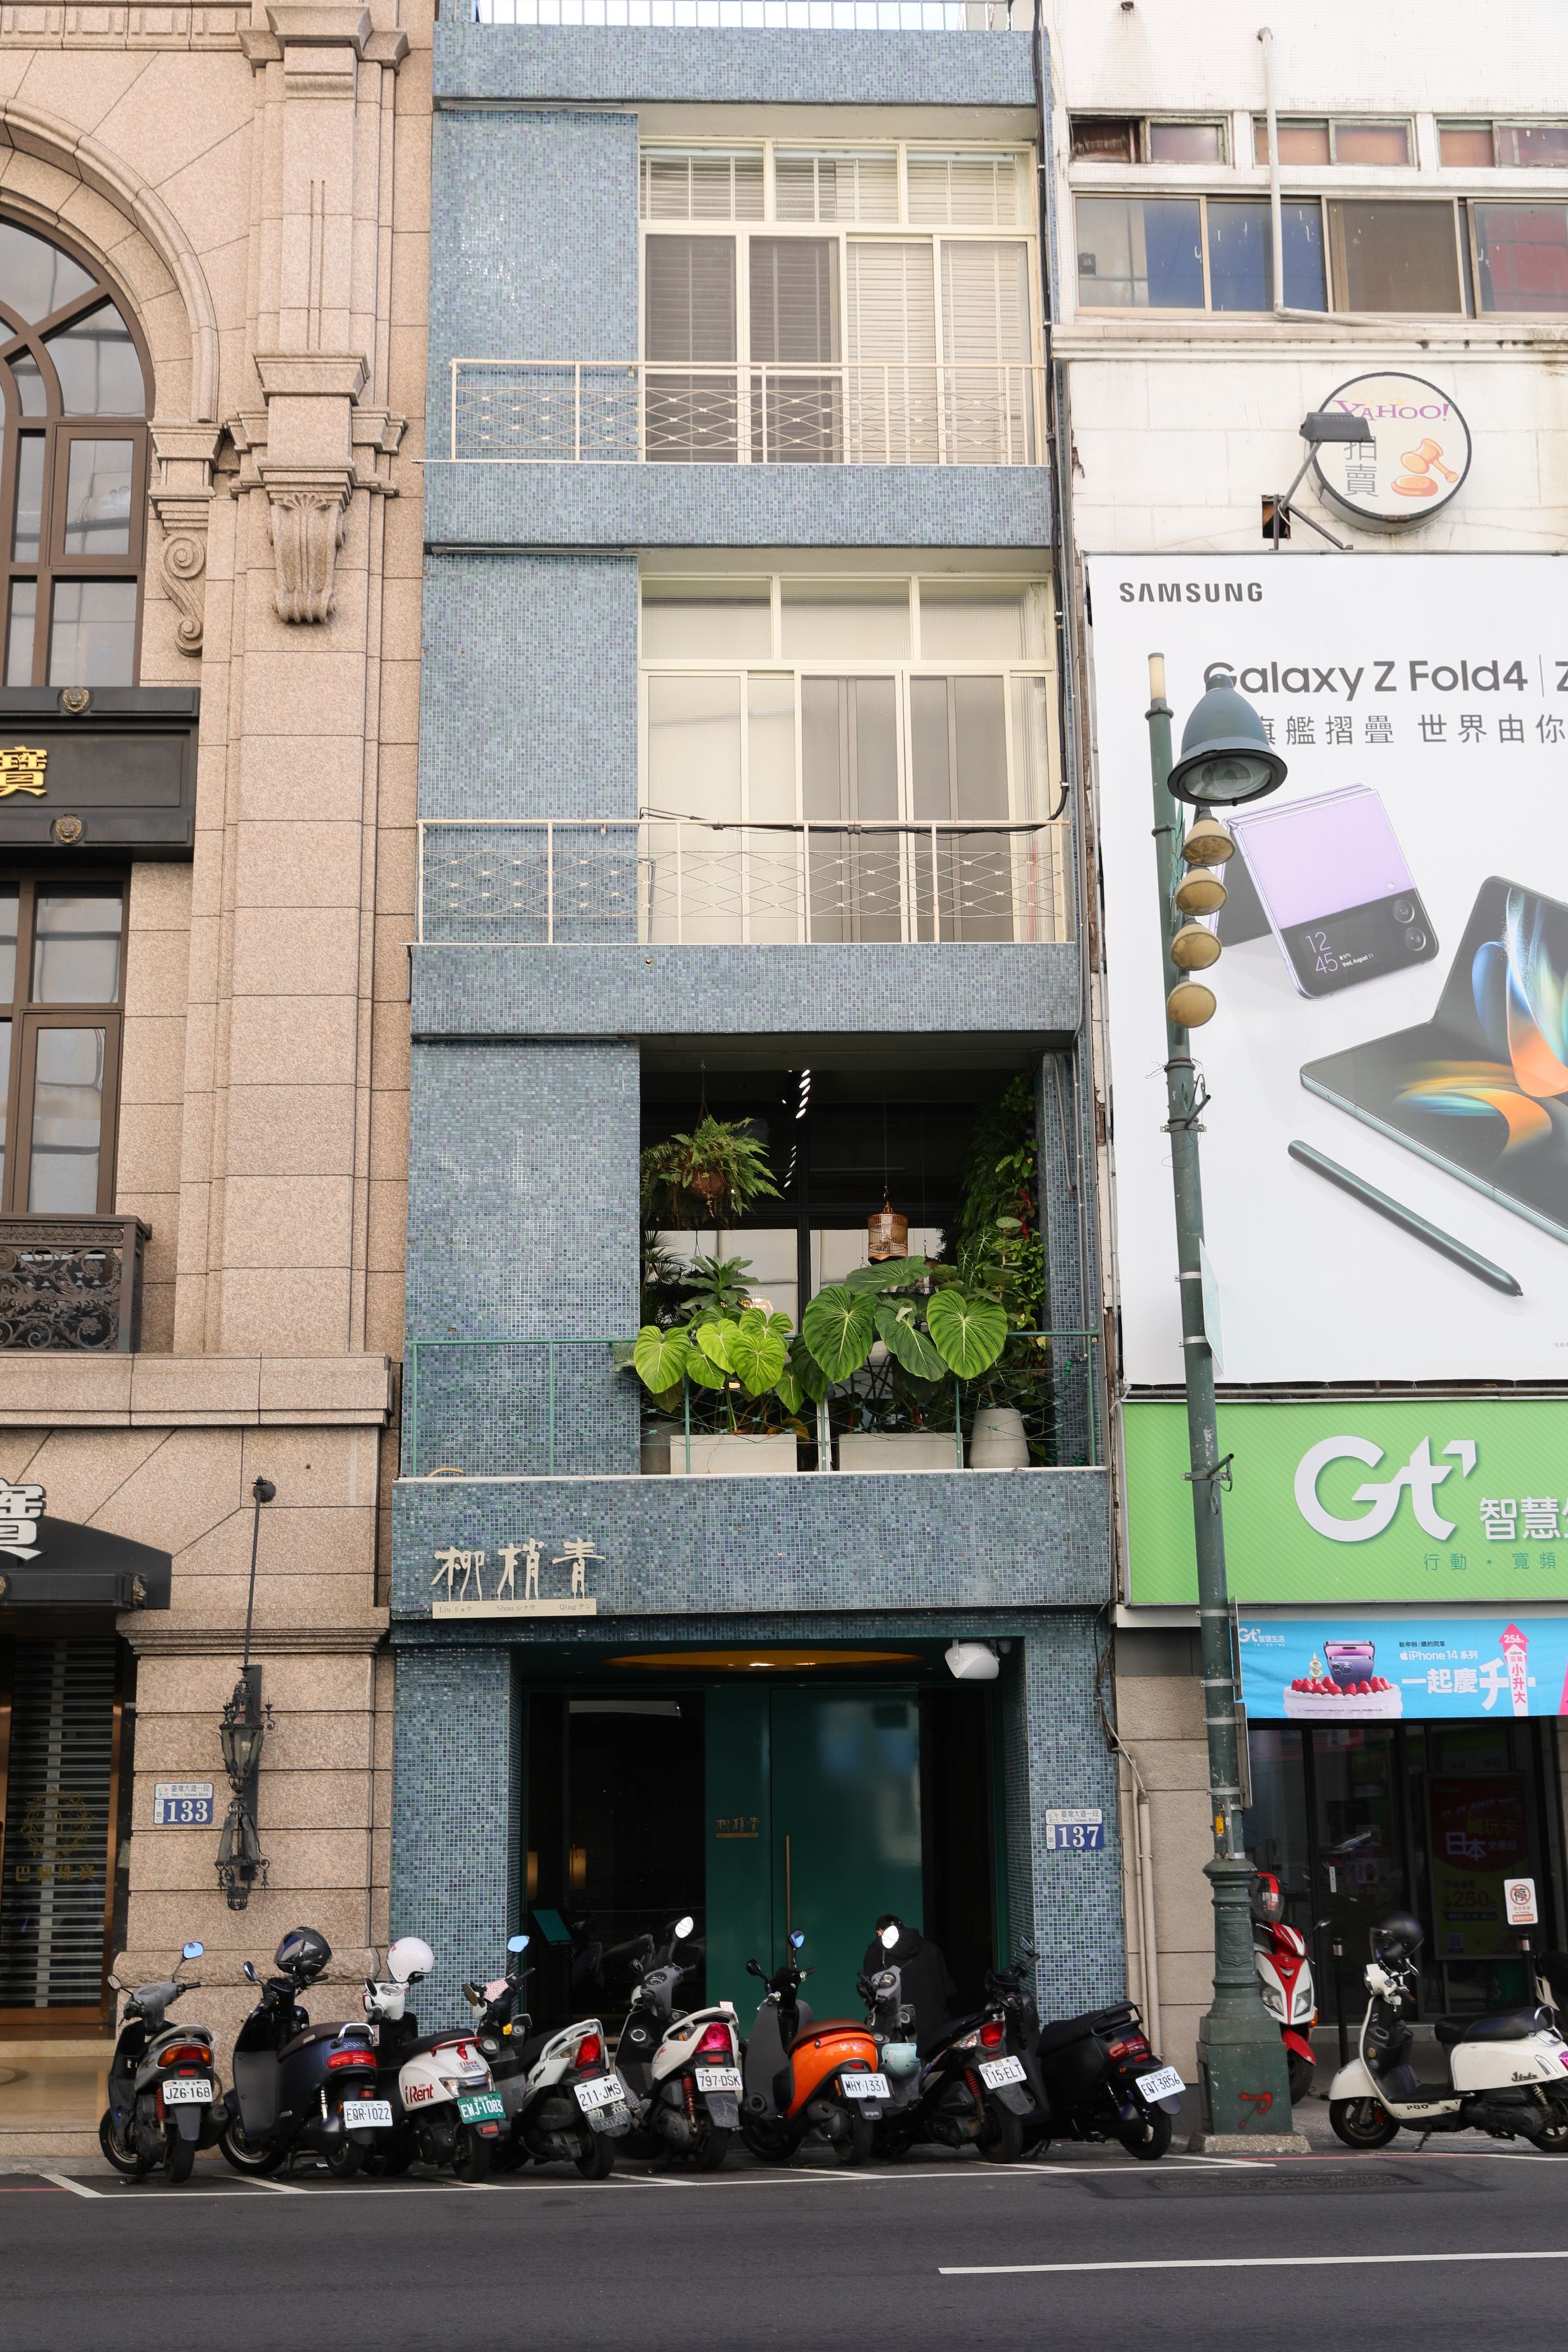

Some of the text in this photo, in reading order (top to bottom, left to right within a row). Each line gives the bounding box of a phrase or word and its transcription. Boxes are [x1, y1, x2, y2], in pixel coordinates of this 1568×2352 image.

[1332, 400, 1450, 421] YAHOO!
[1119, 582, 1264, 603] SAMSUNG
[1373, 661, 1397, 692] Z
[1409, 660, 1528, 692] Fold4
[1417, 713, 1566, 743] 世界由你
[1305, 932, 1331, 953] 12
[1315, 952, 1339, 973] 45
[1409, 1651, 1446, 1660] iPhone
[1446, 1650, 1459, 1660] 14
[167, 1800, 208, 1822] 133
[1058, 1825, 1100, 1848] 137
[1445, 1831, 1488, 1861] 日本
[698, 2075, 741, 2087] 797-DSK
[985, 2064, 1022, 2085] 115-ELT
[1140, 2072, 1181, 2097] EQT-3856
[165, 2087, 210, 2100] JZ6-168
[579, 2083, 621, 2107] 211-JMS
[844, 2080, 886, 2092] WHY-1331
[346, 2107, 391, 2122] EQR-1022
